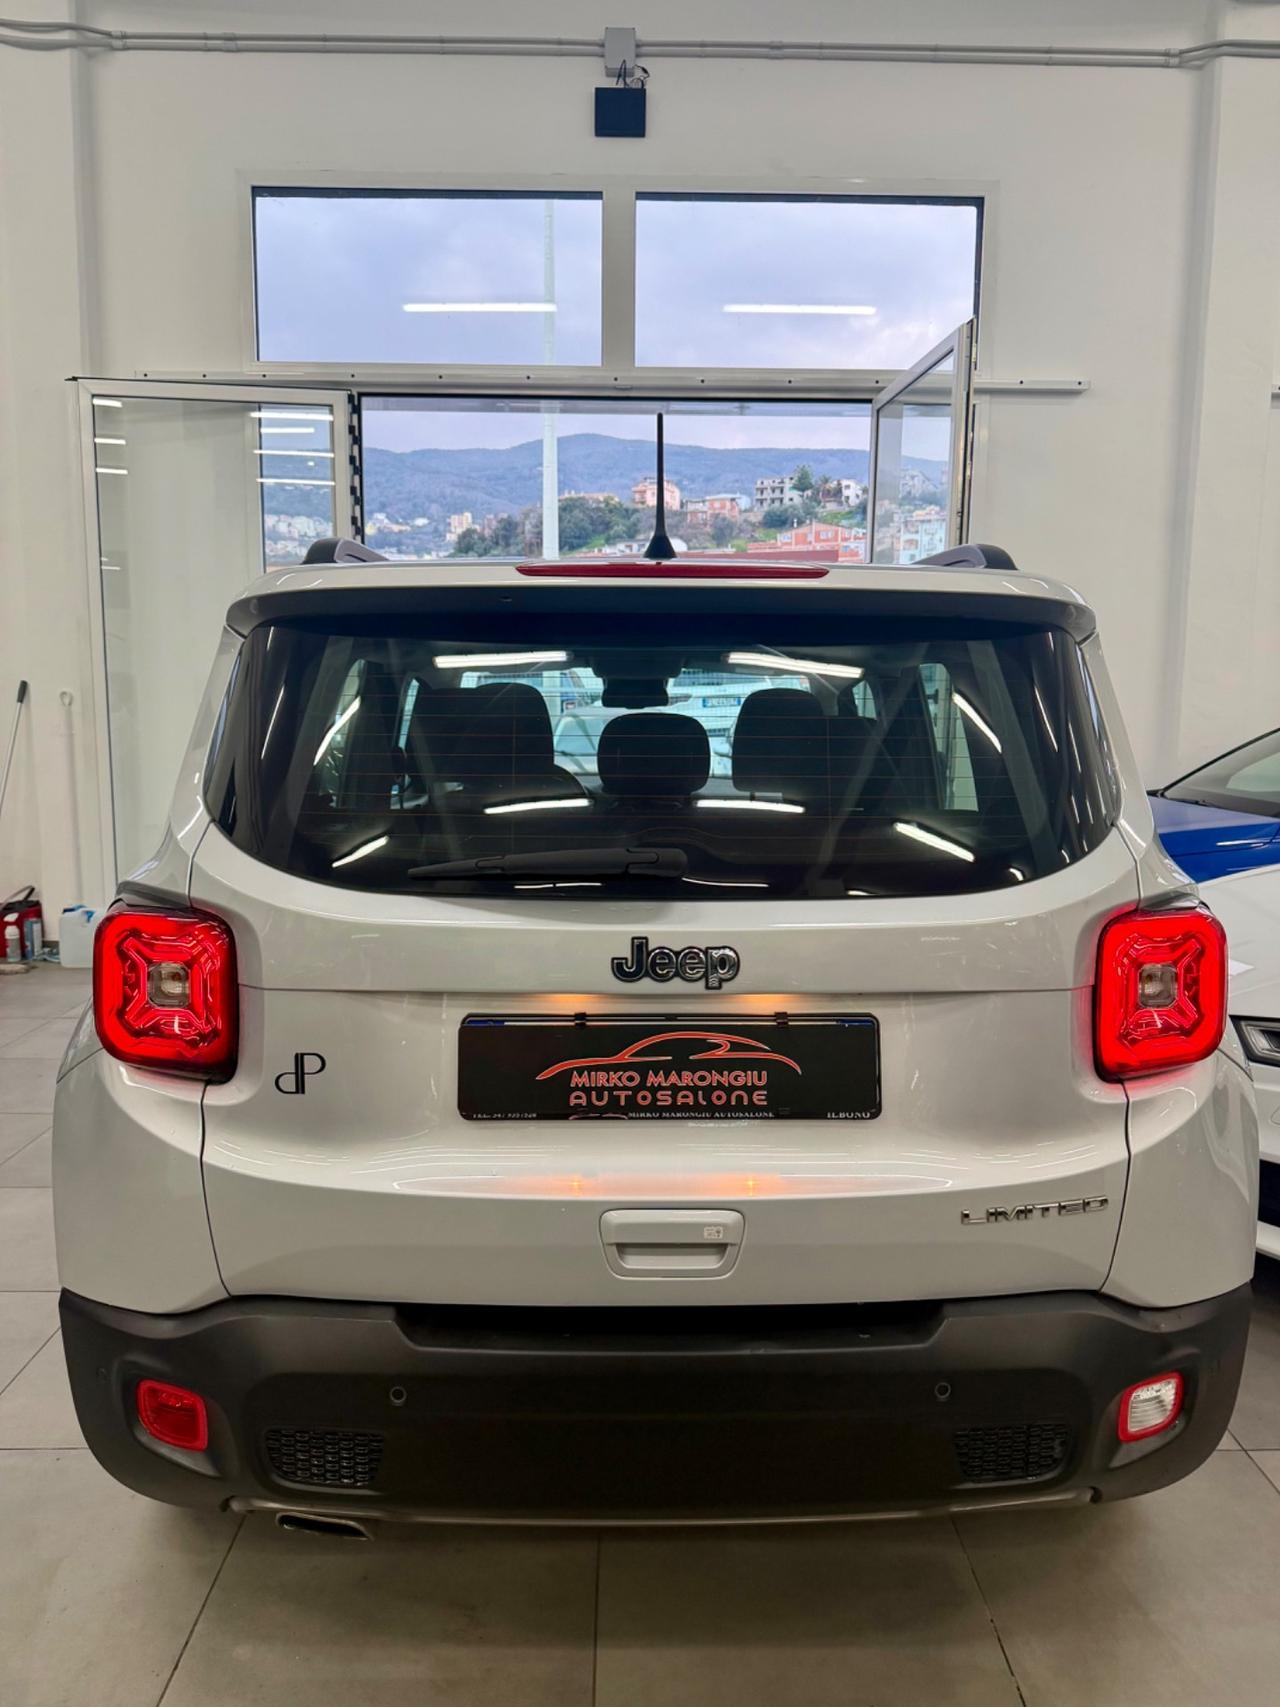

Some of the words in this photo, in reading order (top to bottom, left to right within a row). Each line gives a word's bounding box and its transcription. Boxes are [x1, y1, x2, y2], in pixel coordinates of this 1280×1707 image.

[611, 936, 740, 990] Jeep
[570, 1070, 640, 1087] MIRKO
[646, 1070, 768, 1087] MARONGIU
[569, 1090, 768, 1106] AUTOSALONE
[961, 1195, 1109, 1224] LIMITED
